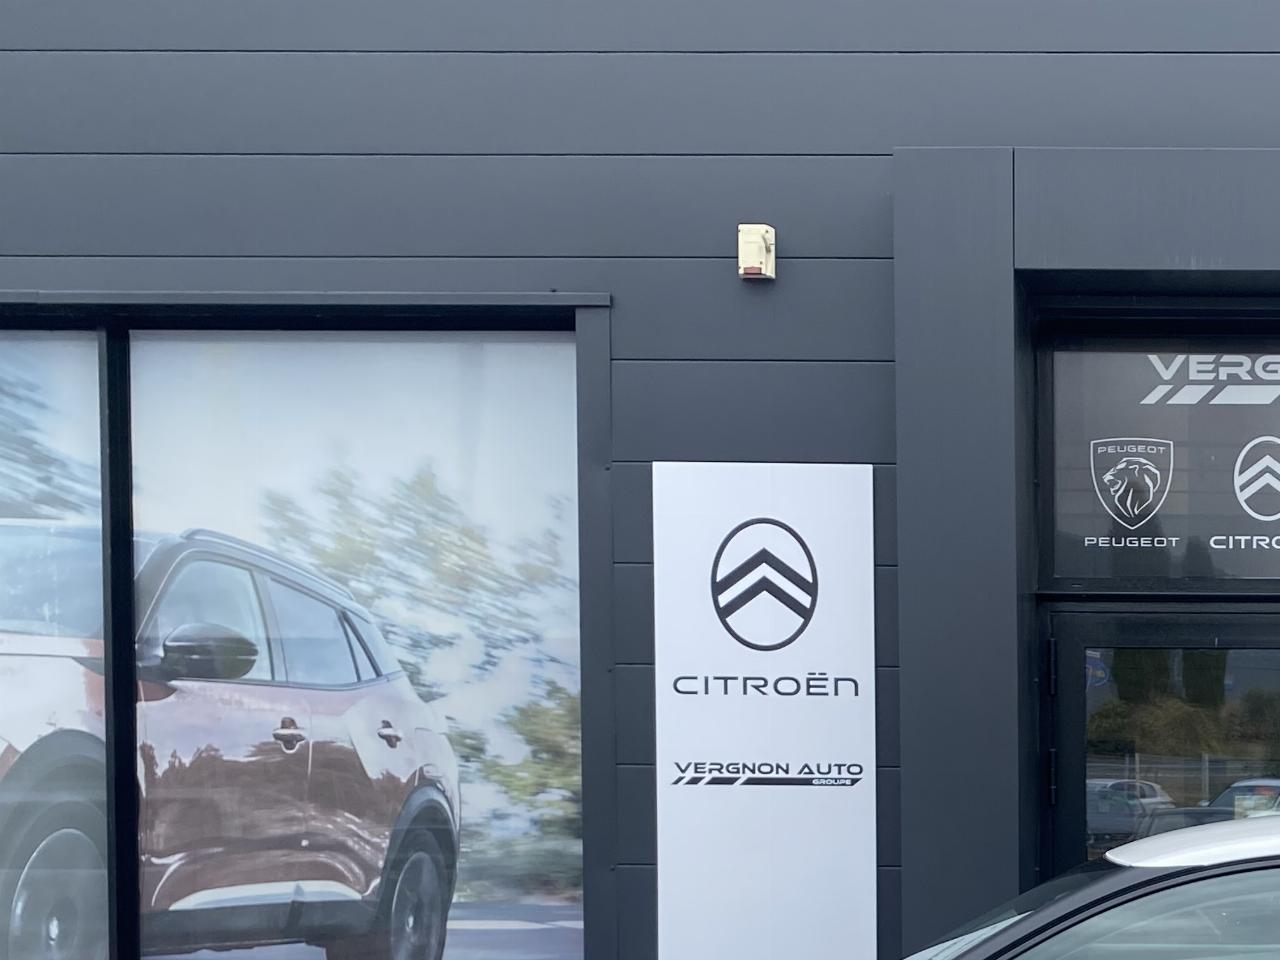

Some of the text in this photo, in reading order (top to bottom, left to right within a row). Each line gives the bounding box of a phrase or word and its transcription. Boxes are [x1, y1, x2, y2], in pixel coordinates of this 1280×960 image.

[1097, 444, 1166, 454] PEUGEOT
[1084, 537, 1180, 547] PEUGEOT
[675, 762, 864, 776] VERGNON AUTO
